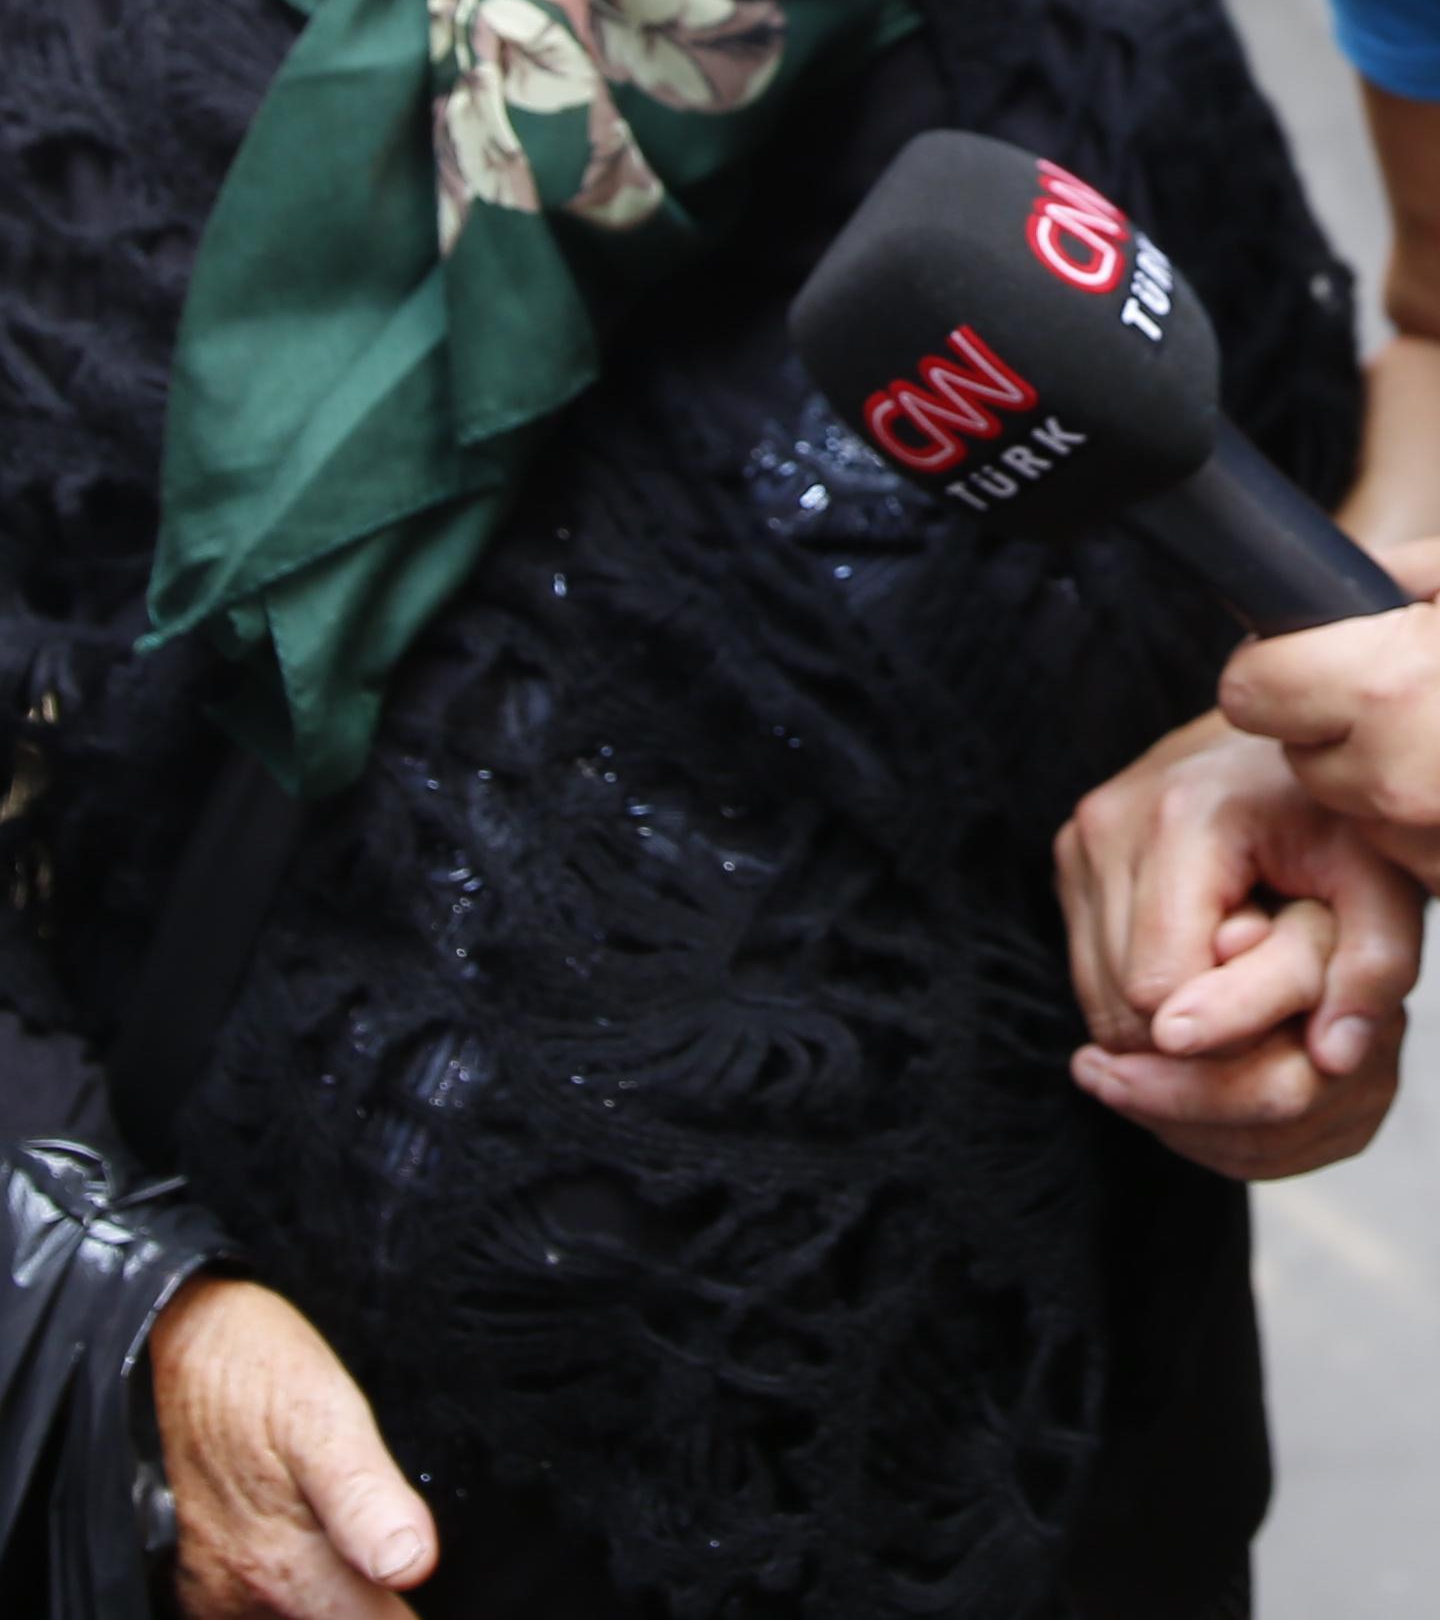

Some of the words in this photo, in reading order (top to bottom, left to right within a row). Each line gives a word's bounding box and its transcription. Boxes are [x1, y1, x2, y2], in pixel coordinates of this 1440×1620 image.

[1026, 157, 1130, 295] CNN
[864, 323, 1039, 473] CNN
[945, 415, 1088, 512] TÜRK
